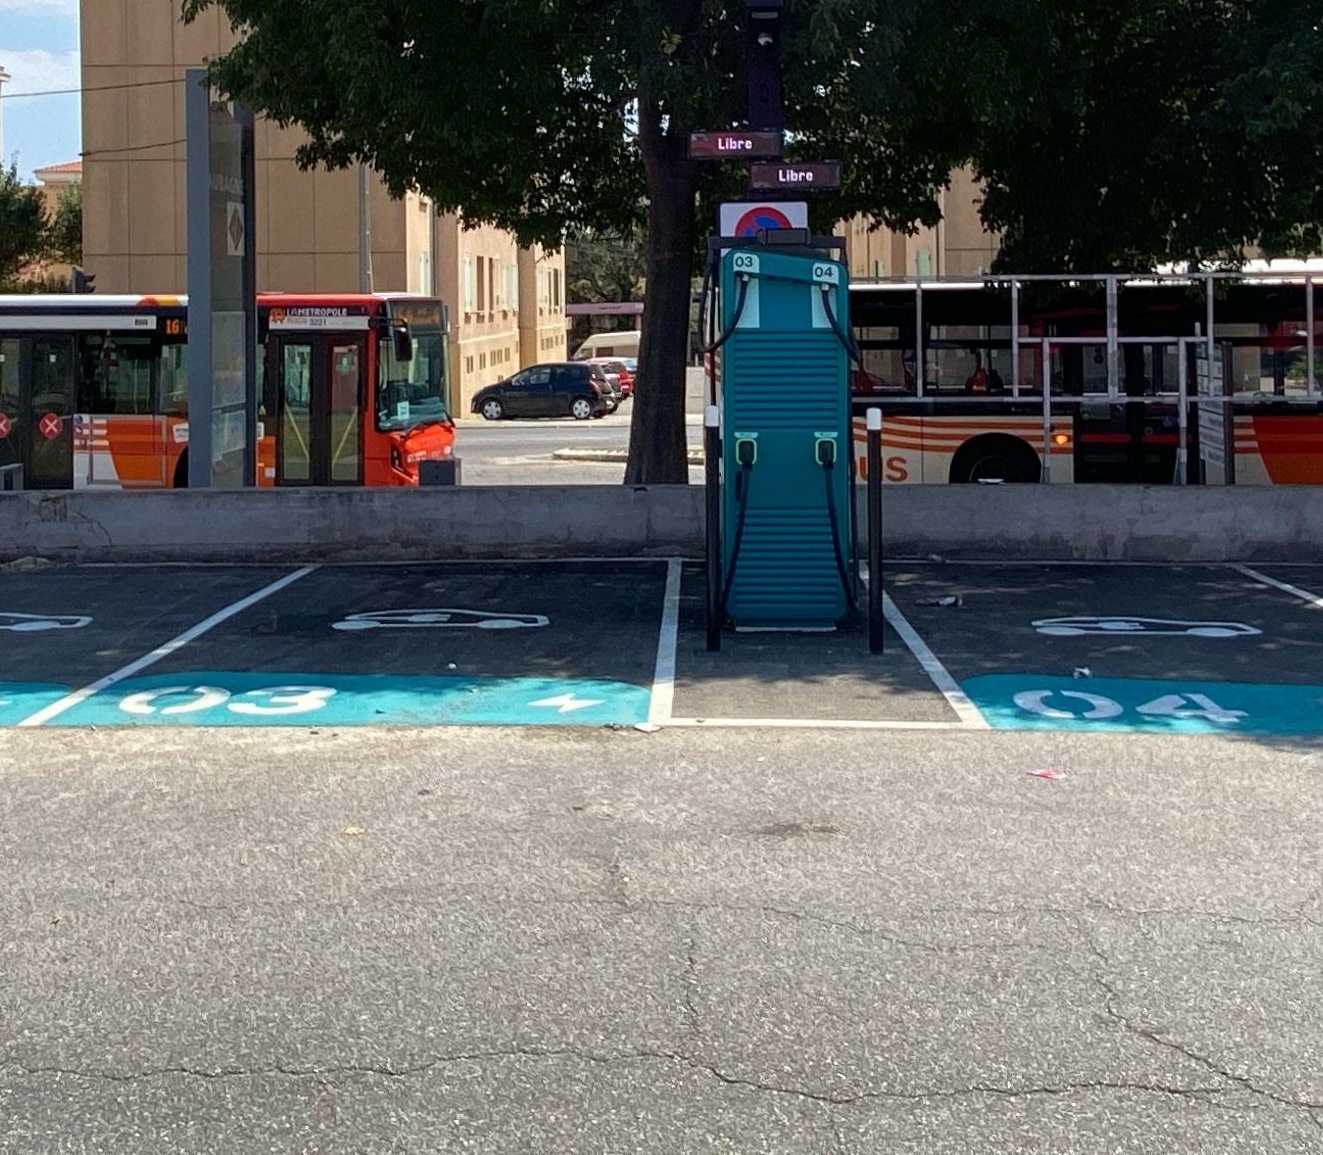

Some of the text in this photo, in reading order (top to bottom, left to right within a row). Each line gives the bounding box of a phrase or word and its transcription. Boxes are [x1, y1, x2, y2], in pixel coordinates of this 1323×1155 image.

[718, 138, 753, 150] Libre
[779, 169, 814, 182] Libre
[735, 256, 753, 268] 03
[814, 267, 833, 278] 04
[166, 319, 179, 334] 16
[118, 685, 337, 715] 03
[1013, 688, 1249, 723] 04
